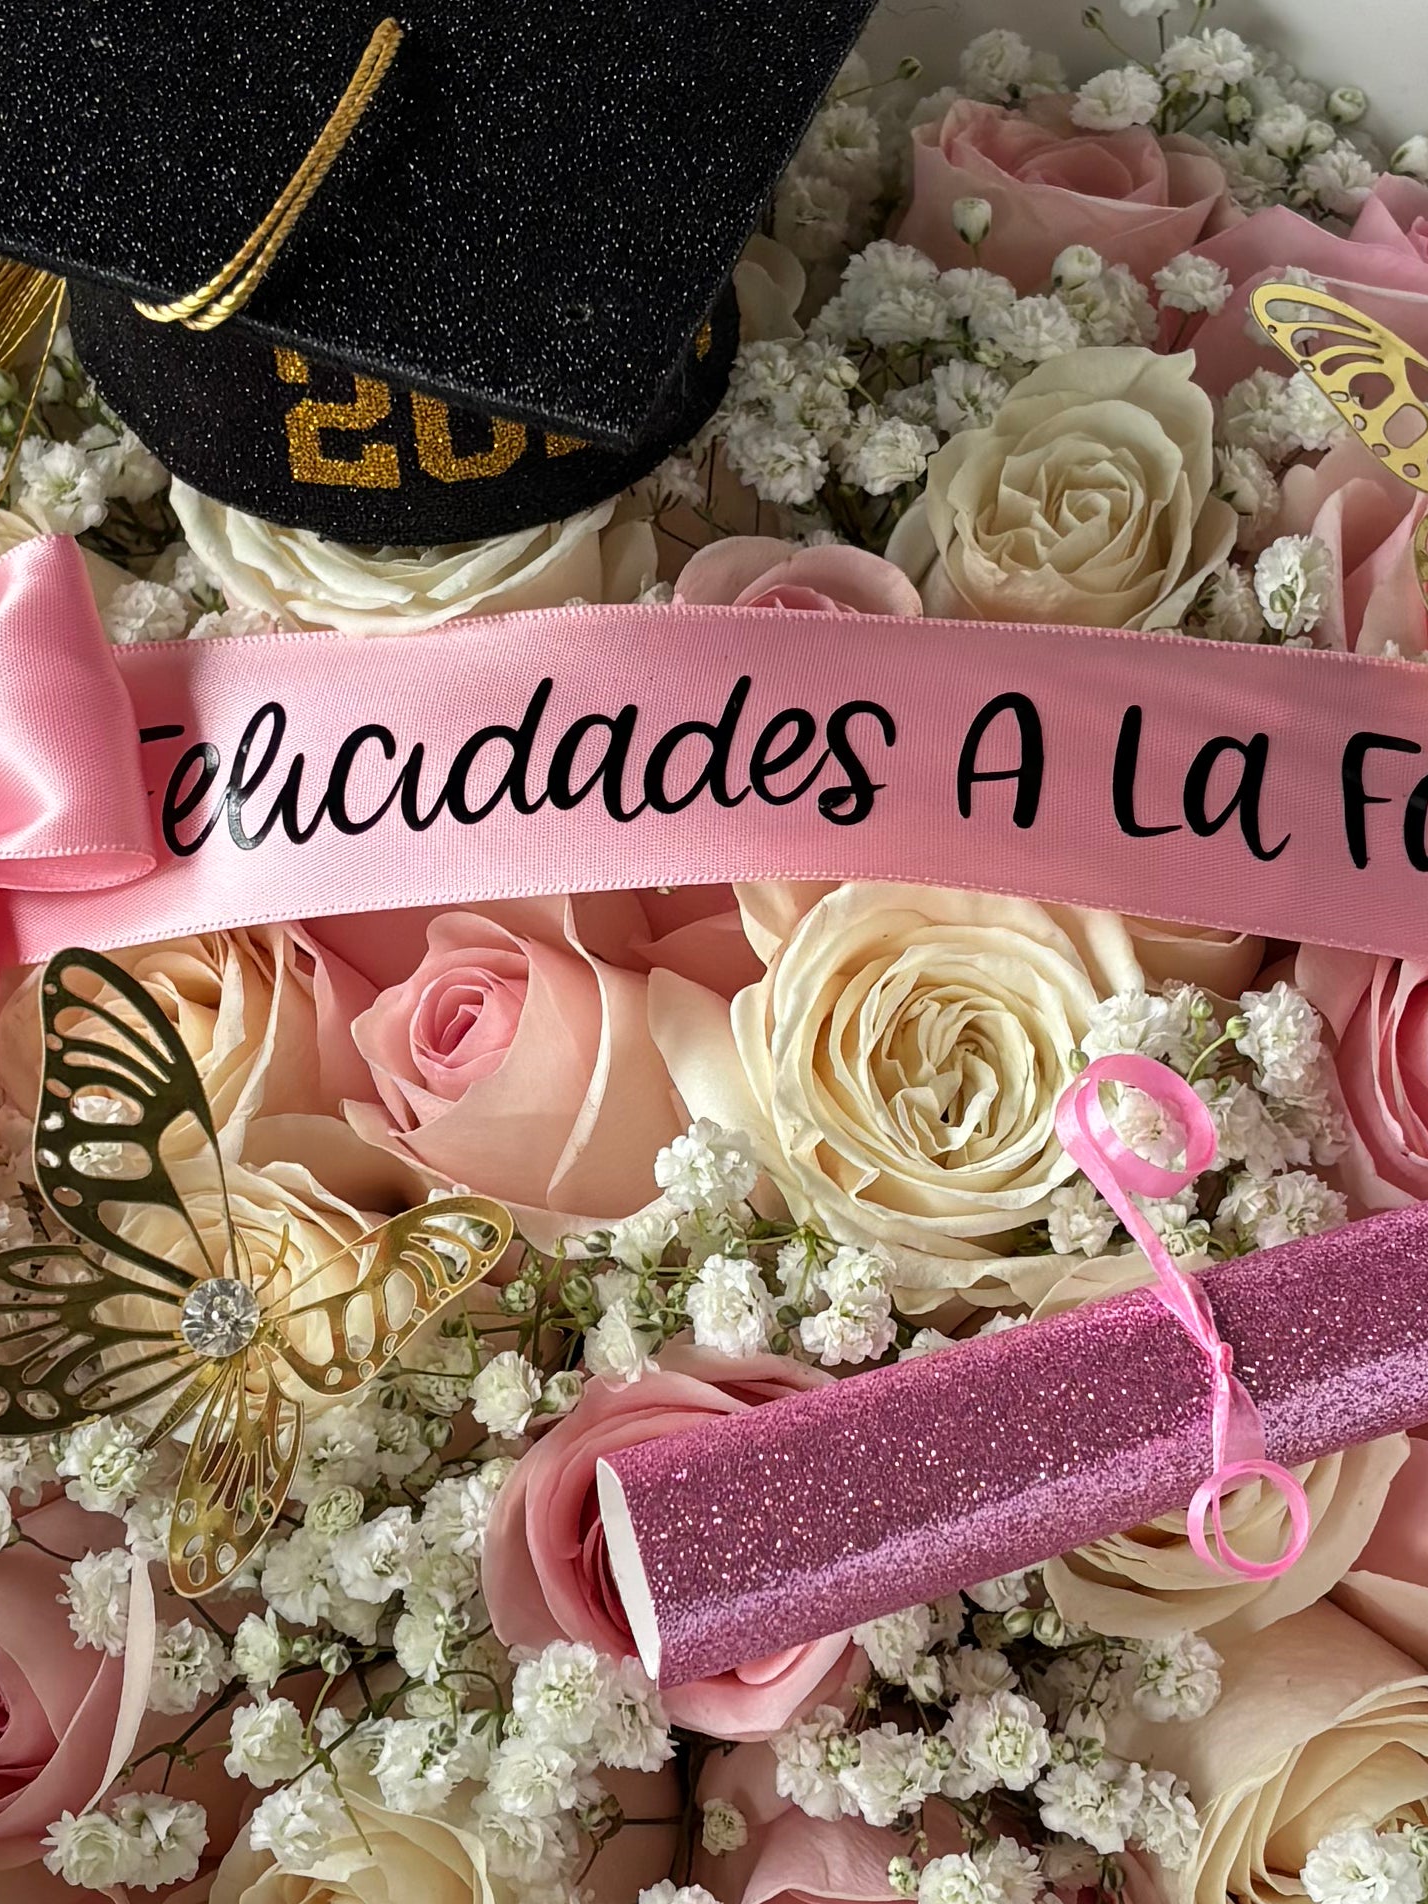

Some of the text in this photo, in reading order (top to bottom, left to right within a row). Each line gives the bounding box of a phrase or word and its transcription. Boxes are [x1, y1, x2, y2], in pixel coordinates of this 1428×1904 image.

[274, 346, 592, 489] 20
[140, 675, 897, 858] elicidades
[956, 692, 1046, 829] A
[1110, 704, 1291, 862] La
